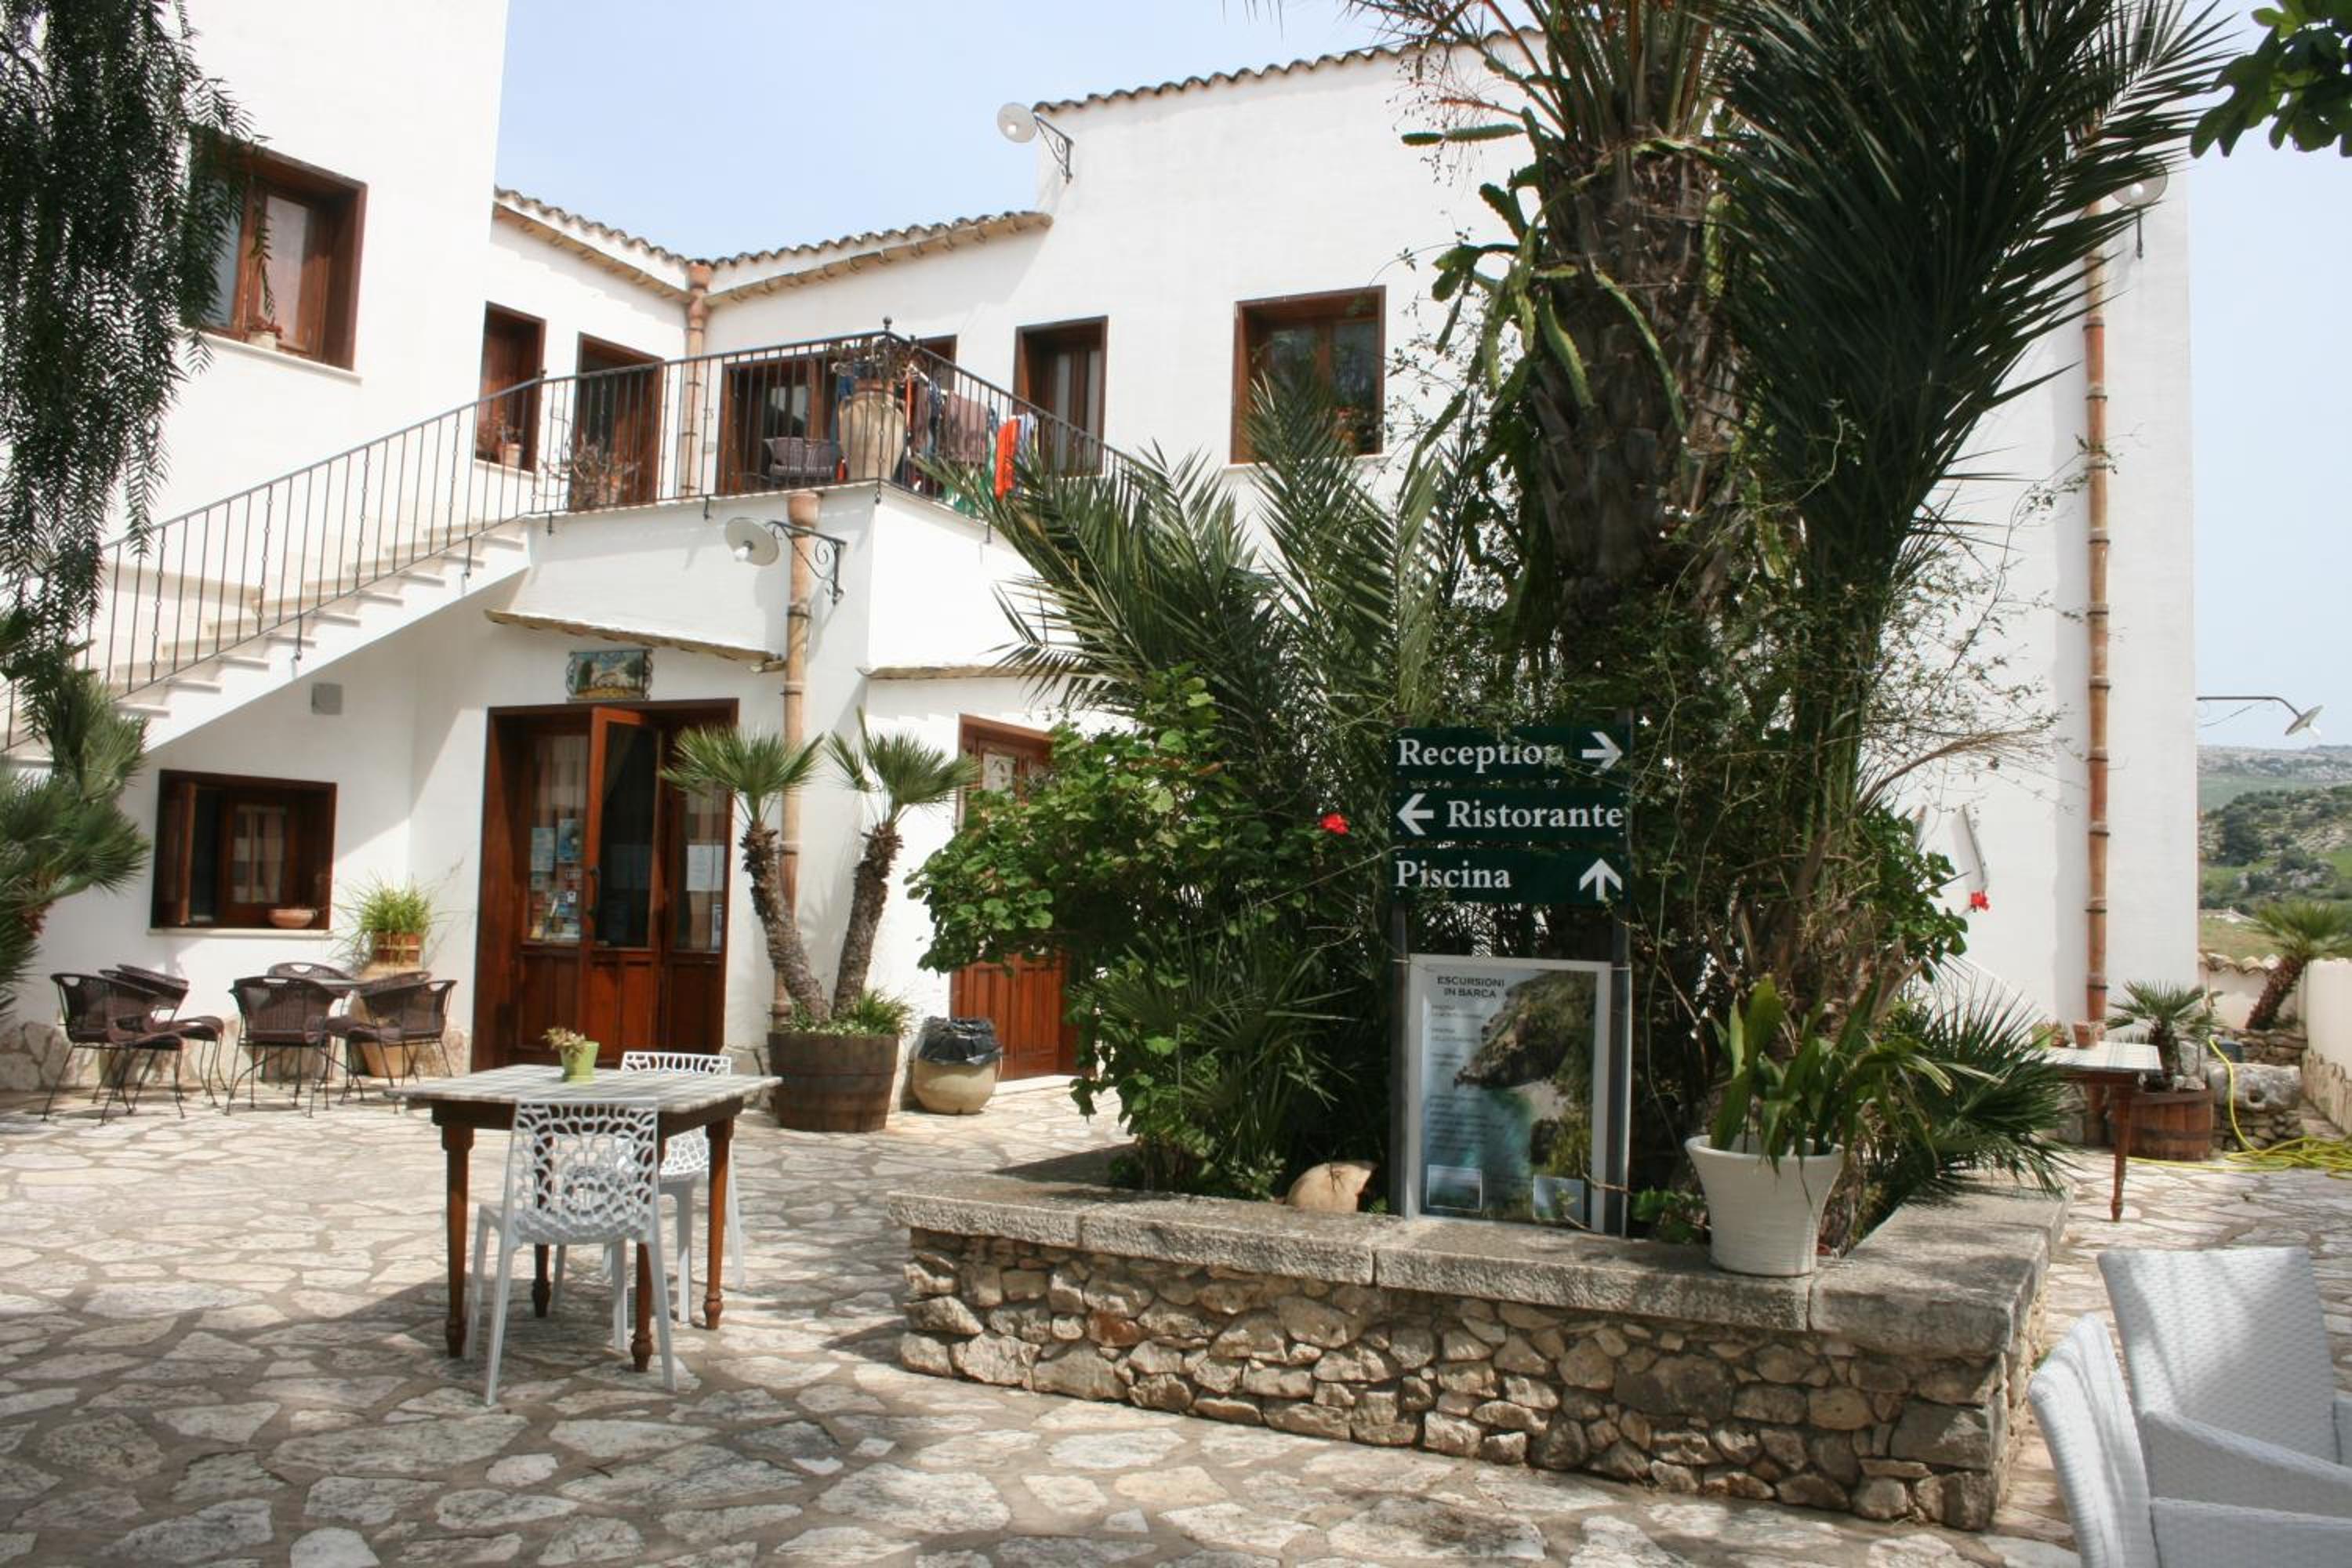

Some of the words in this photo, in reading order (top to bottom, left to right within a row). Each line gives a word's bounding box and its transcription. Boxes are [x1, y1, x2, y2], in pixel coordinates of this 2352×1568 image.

[1447, 800, 1624, 828] Ristorante
[1396, 860, 1512, 888] Piscina
[1437, 975, 1504, 988] ESCURSIONI
[1444, 988, 1456, 996] IN
[1458, 989, 1497, 999] BARCA
